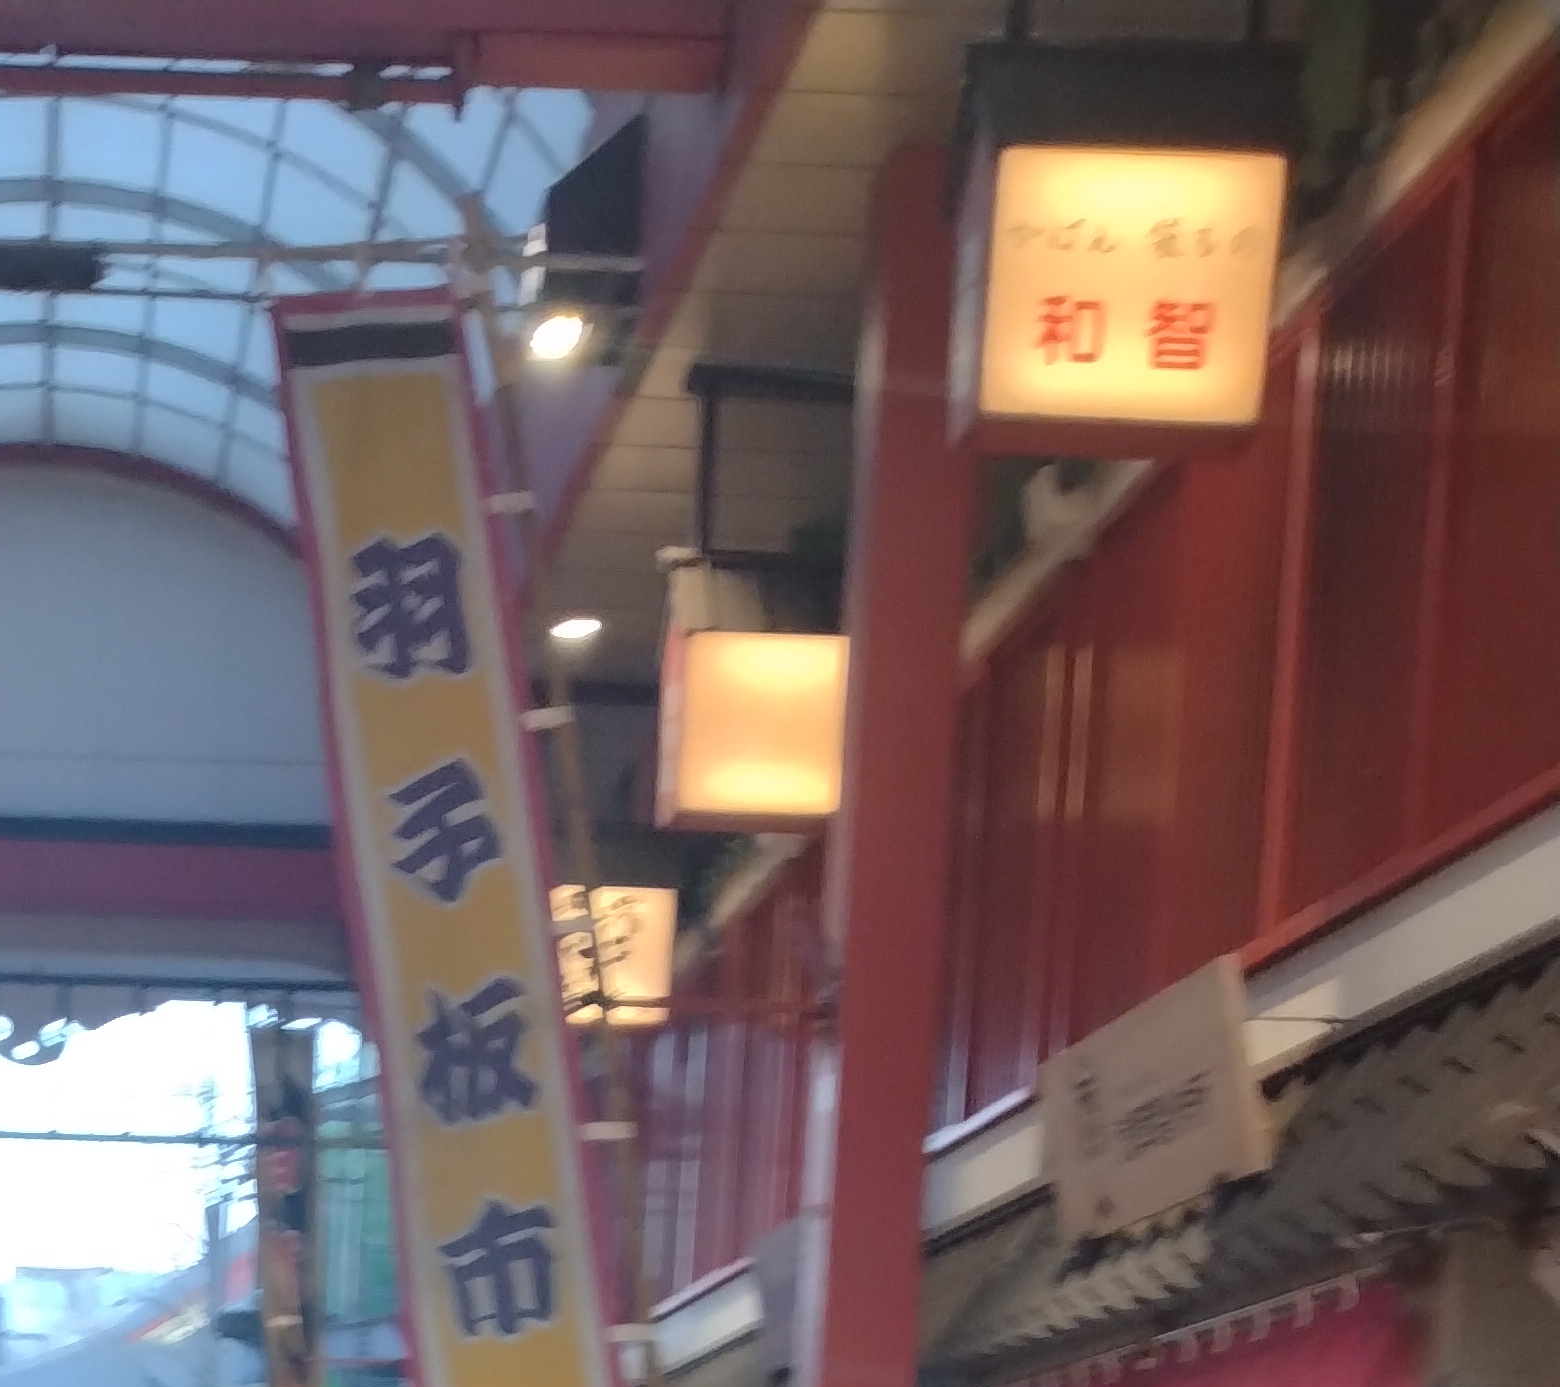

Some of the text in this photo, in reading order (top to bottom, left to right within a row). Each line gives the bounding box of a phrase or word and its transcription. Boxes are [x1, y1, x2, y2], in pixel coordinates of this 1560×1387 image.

[1035, 295, 1217, 370] 和智
[351, 533, 558, 1337] 羽子板市
